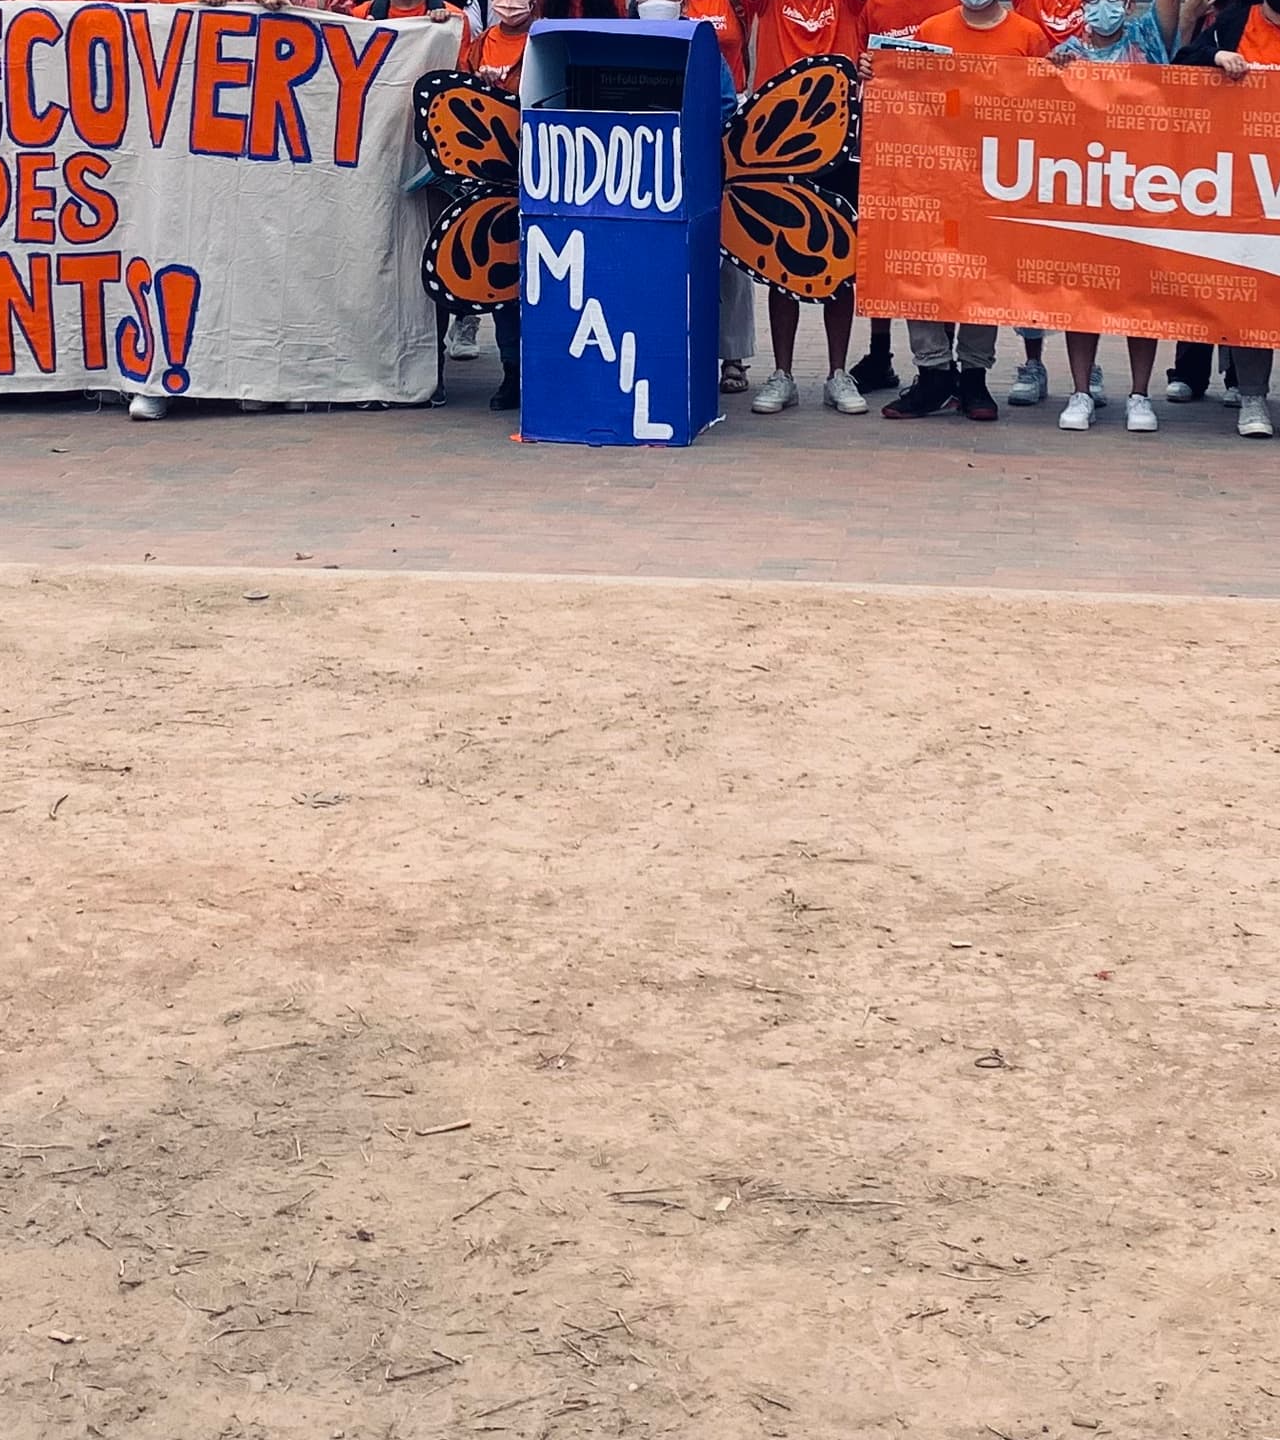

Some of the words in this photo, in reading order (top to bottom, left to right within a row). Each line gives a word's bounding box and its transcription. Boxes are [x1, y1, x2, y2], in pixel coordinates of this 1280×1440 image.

[897, 57, 934, 71] HERE
[937, 60, 955, 73] TO
[1092, 68, 1131, 81] STAY!
[1161, 71, 1198, 85] HERE
[1226, 74, 1267, 88] SAY!
[885, 101, 903, 114] TO
[908, 103, 945, 116] STAY!
[974, 95, 1076, 112] UNDOCUMENTED
[1106, 103, 1211, 120] UNDOCUMENTED
[974, 109, 1012, 122] HERE
[1015, 111, 1033, 123] TO
[1037, 112, 1076, 127] STAY!
[1106, 116, 1145, 130] HERE
[1149, 118, 1168, 130] TO
[1172, 119, 1211, 133] STAY!
[875, 142, 977, 159] UNDOCUMENTED
[521, 122, 683, 212] UNDOCU
[875, 156, 913, 169] HERE
[916, 157, 935, 170] TO
[939, 158, 977, 172] STAY!
[982, 136, 1233, 215] United
[880, 208, 897, 220] TO
[902, 209, 940, 223] STAY!
[885, 250, 987, 265] UNDOCUMENTED
[885, 261, 922, 275] HERE
[925, 264, 943, 276] TO
[948, 265, 987, 279] STAY!
[1017, 270, 1056, 285] HERE
[1060, 272, 1077, 286] TO
[1150, 270, 1257, 288] UNDOCUMENTED
[1150, 283, 1188, 298] HERE
[1192, 285, 1212, 299] TO
[525, 224, 674, 440] MAIL
